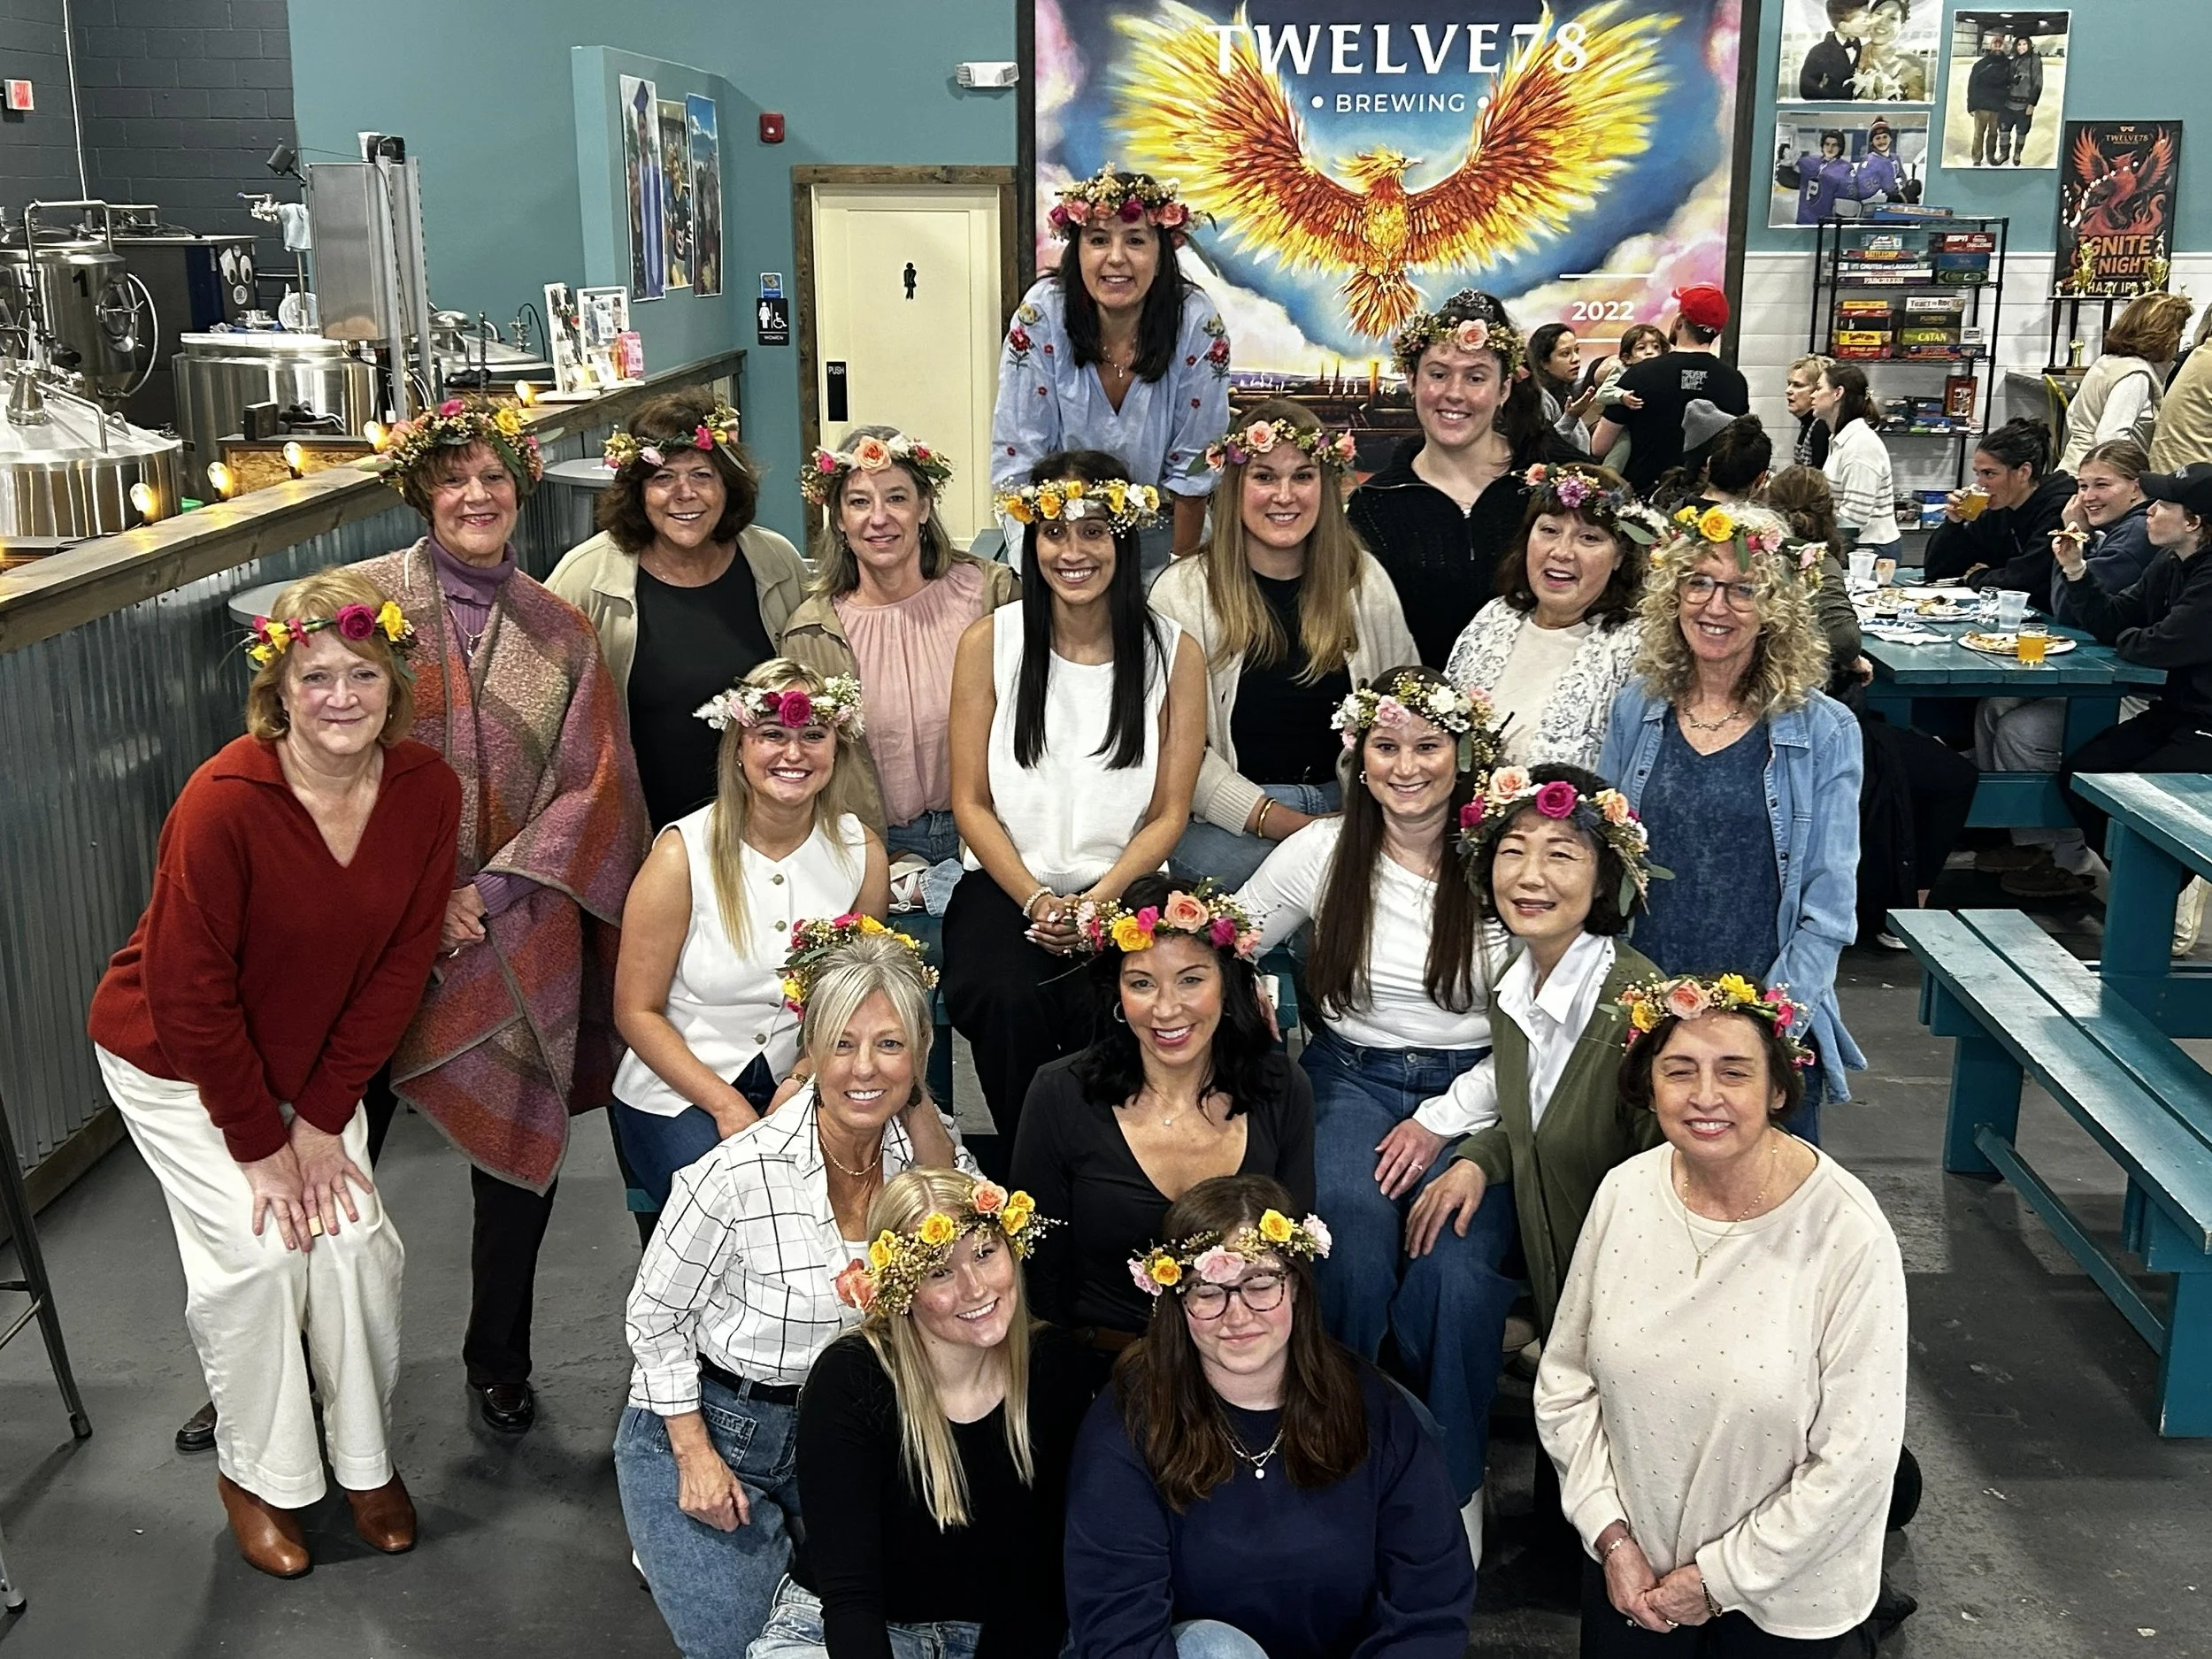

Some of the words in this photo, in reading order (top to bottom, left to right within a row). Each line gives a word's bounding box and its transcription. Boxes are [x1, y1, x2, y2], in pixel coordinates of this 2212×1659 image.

[1204, 22, 1588, 74] TWELVE78
[1335, 93, 1466, 113] BREWING
[73, 269, 88, 297] 1
[2121, 281, 2138, 294] IP
[1571, 301, 1635, 321] 2022
[1917, 333, 1947, 342] CATAN
[828, 365, 845, 375] PUSH
